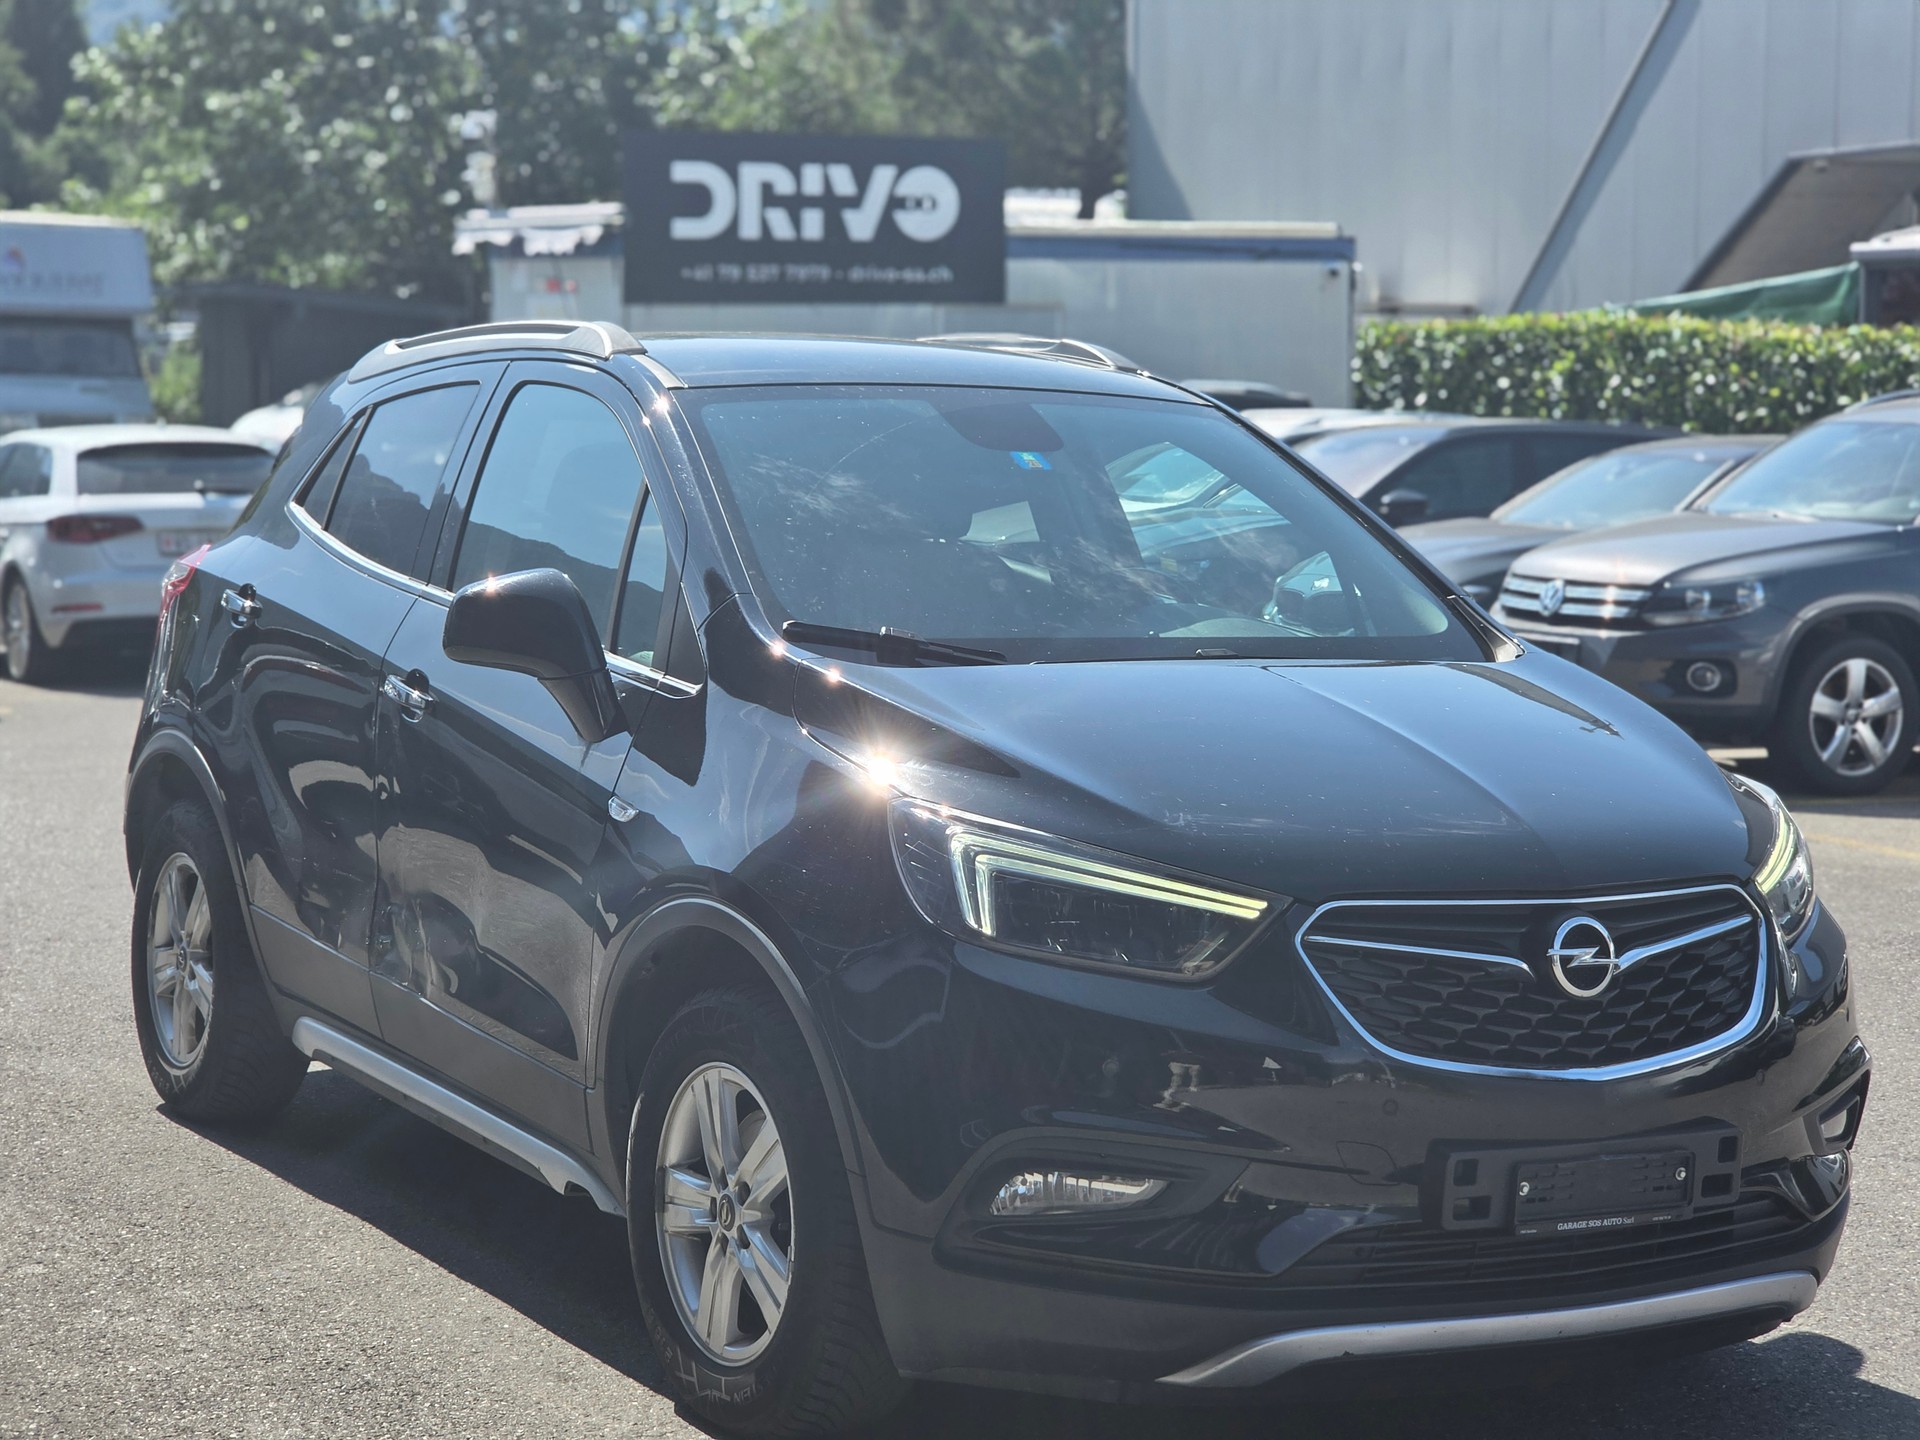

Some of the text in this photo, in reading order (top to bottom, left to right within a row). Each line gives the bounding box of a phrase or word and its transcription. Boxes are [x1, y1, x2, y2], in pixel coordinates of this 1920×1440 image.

[669, 160, 960, 242] DRIVO
[716, 263, 742, 282] 79
[1557, 1220, 1587, 1231] GARAGE
[1587, 1219, 1602, 1228] SOS
[1602, 1217, 1622, 1227] AUTO
